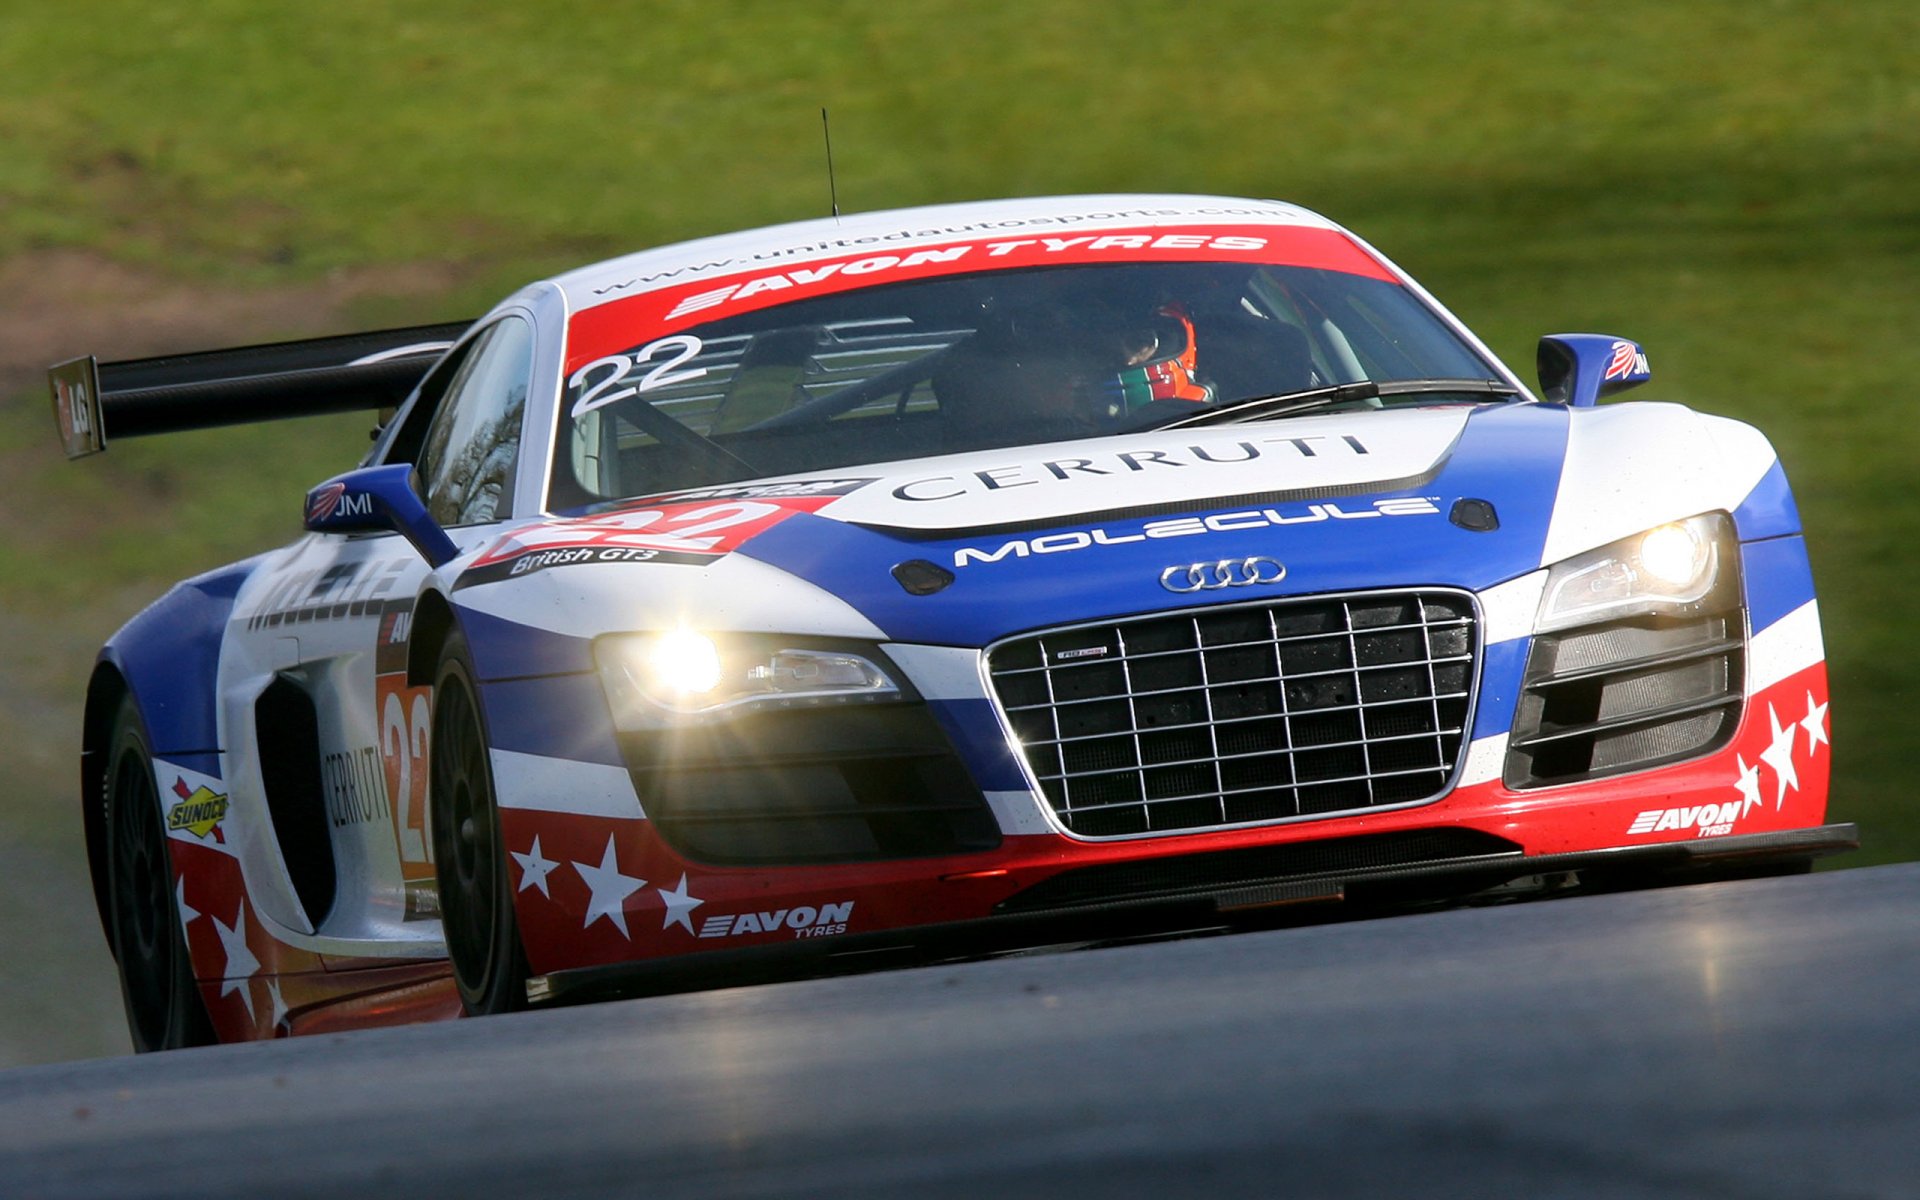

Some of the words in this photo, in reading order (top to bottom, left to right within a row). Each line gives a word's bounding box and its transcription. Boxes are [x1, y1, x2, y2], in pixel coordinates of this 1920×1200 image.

[731, 245, 973, 301] AVON
[986, 234, 1268, 257] TYRES
[569, 334, 708, 418] 22
[892, 434, 1371, 502] CERRUTI
[335, 492, 372, 517] JMI
[490, 501, 781, 558] 22
[954, 497, 1440, 567] MOLECULE
[509, 546, 594, 576] British
[596, 547, 661, 563] GT3
[325, 746, 389, 828] CERRUTI
[170, 798, 227, 828] SUNOCO
[1653, 801, 1743, 832] AVON
[1697, 823, 1733, 838] TYRES
[731, 901, 855, 936] AVON
[794, 923, 847, 939] TYRES
